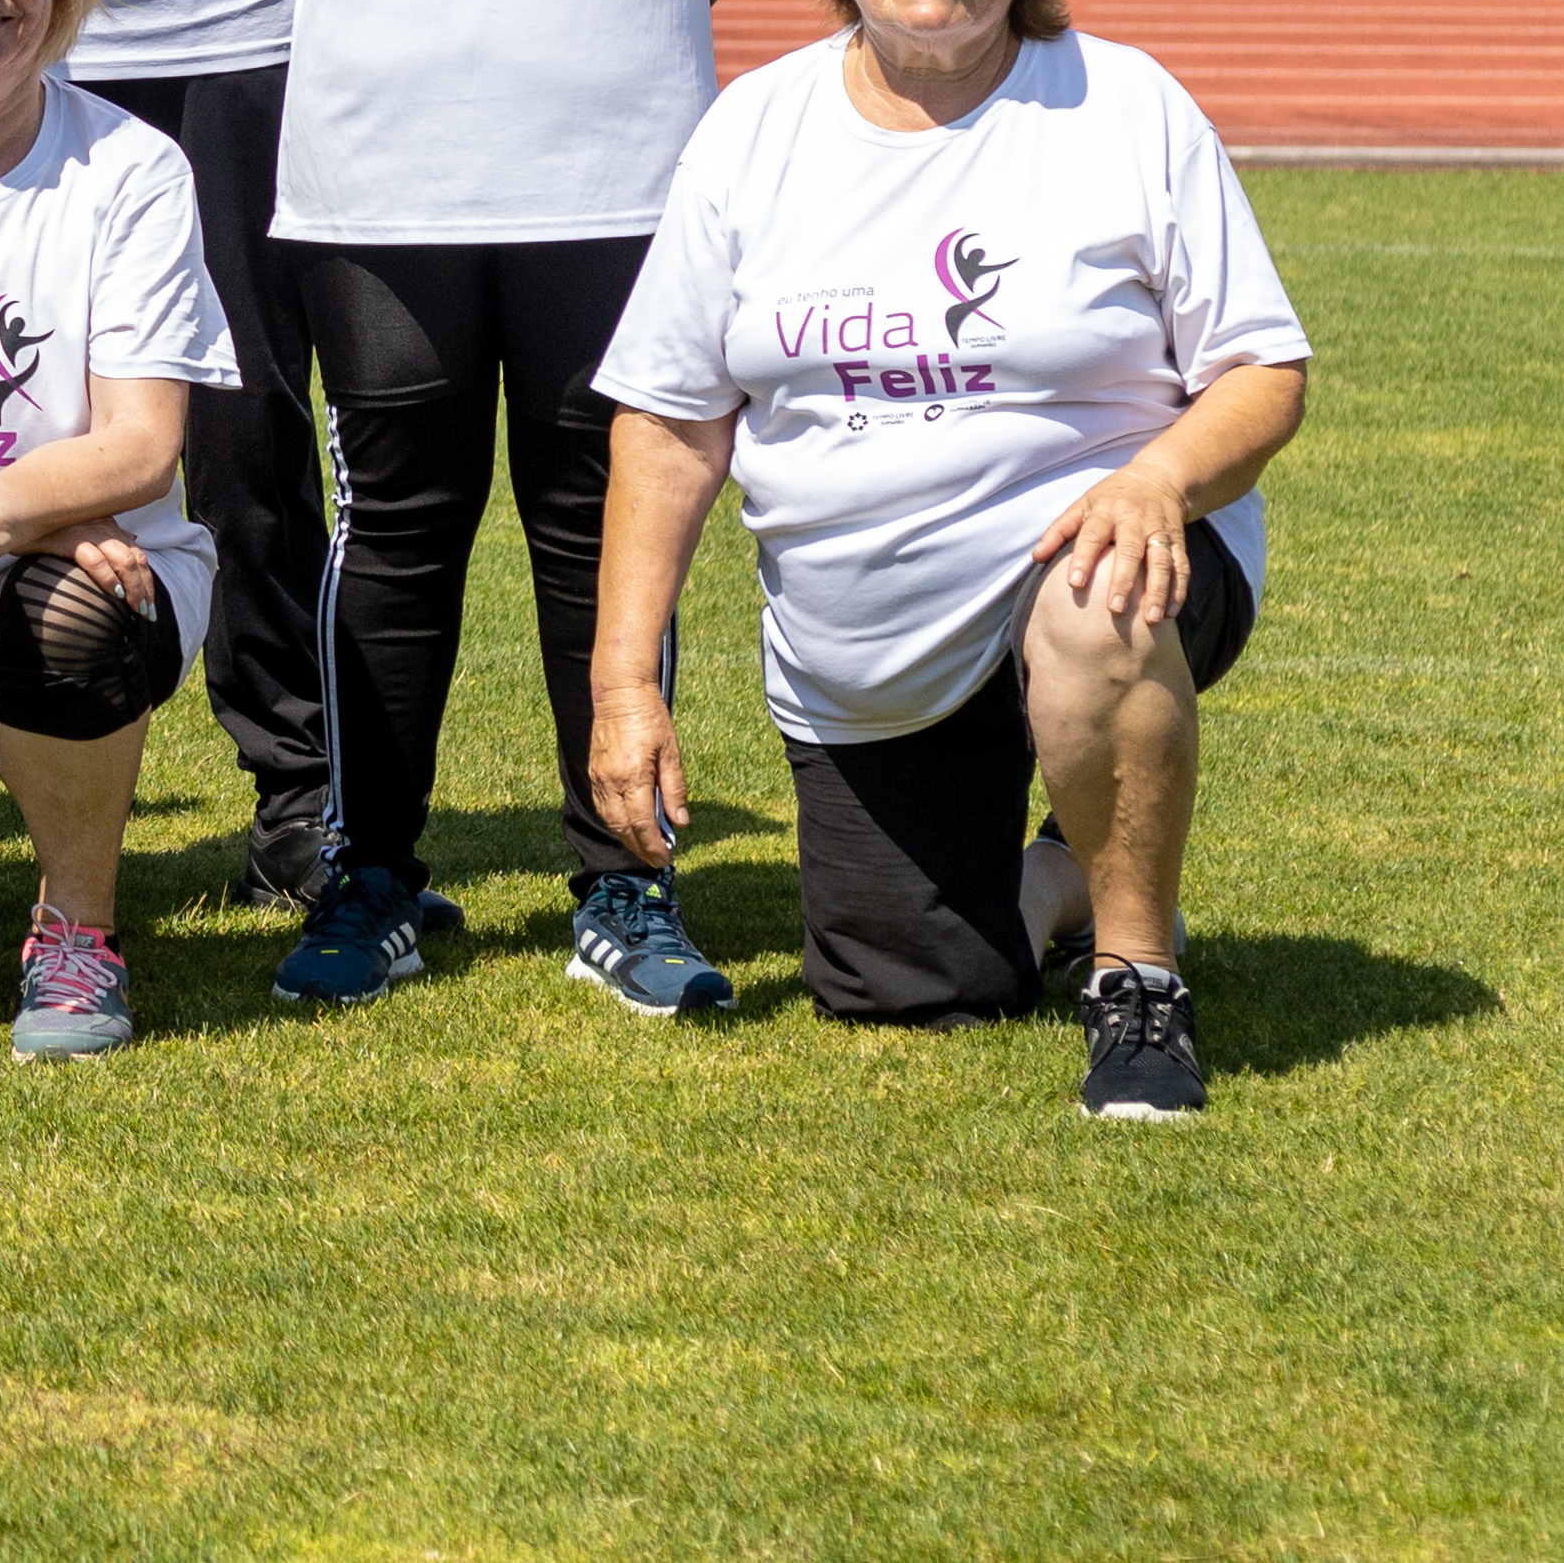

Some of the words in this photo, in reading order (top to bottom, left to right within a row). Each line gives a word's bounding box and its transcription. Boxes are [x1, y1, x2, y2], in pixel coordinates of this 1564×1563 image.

[797, 289, 838, 302] tenho
[843, 286, 875, 297] uma
[776, 302, 919, 358] Vida
[962, 335, 985, 344] TEMPO
[833, 353, 995, 402] Feliz
